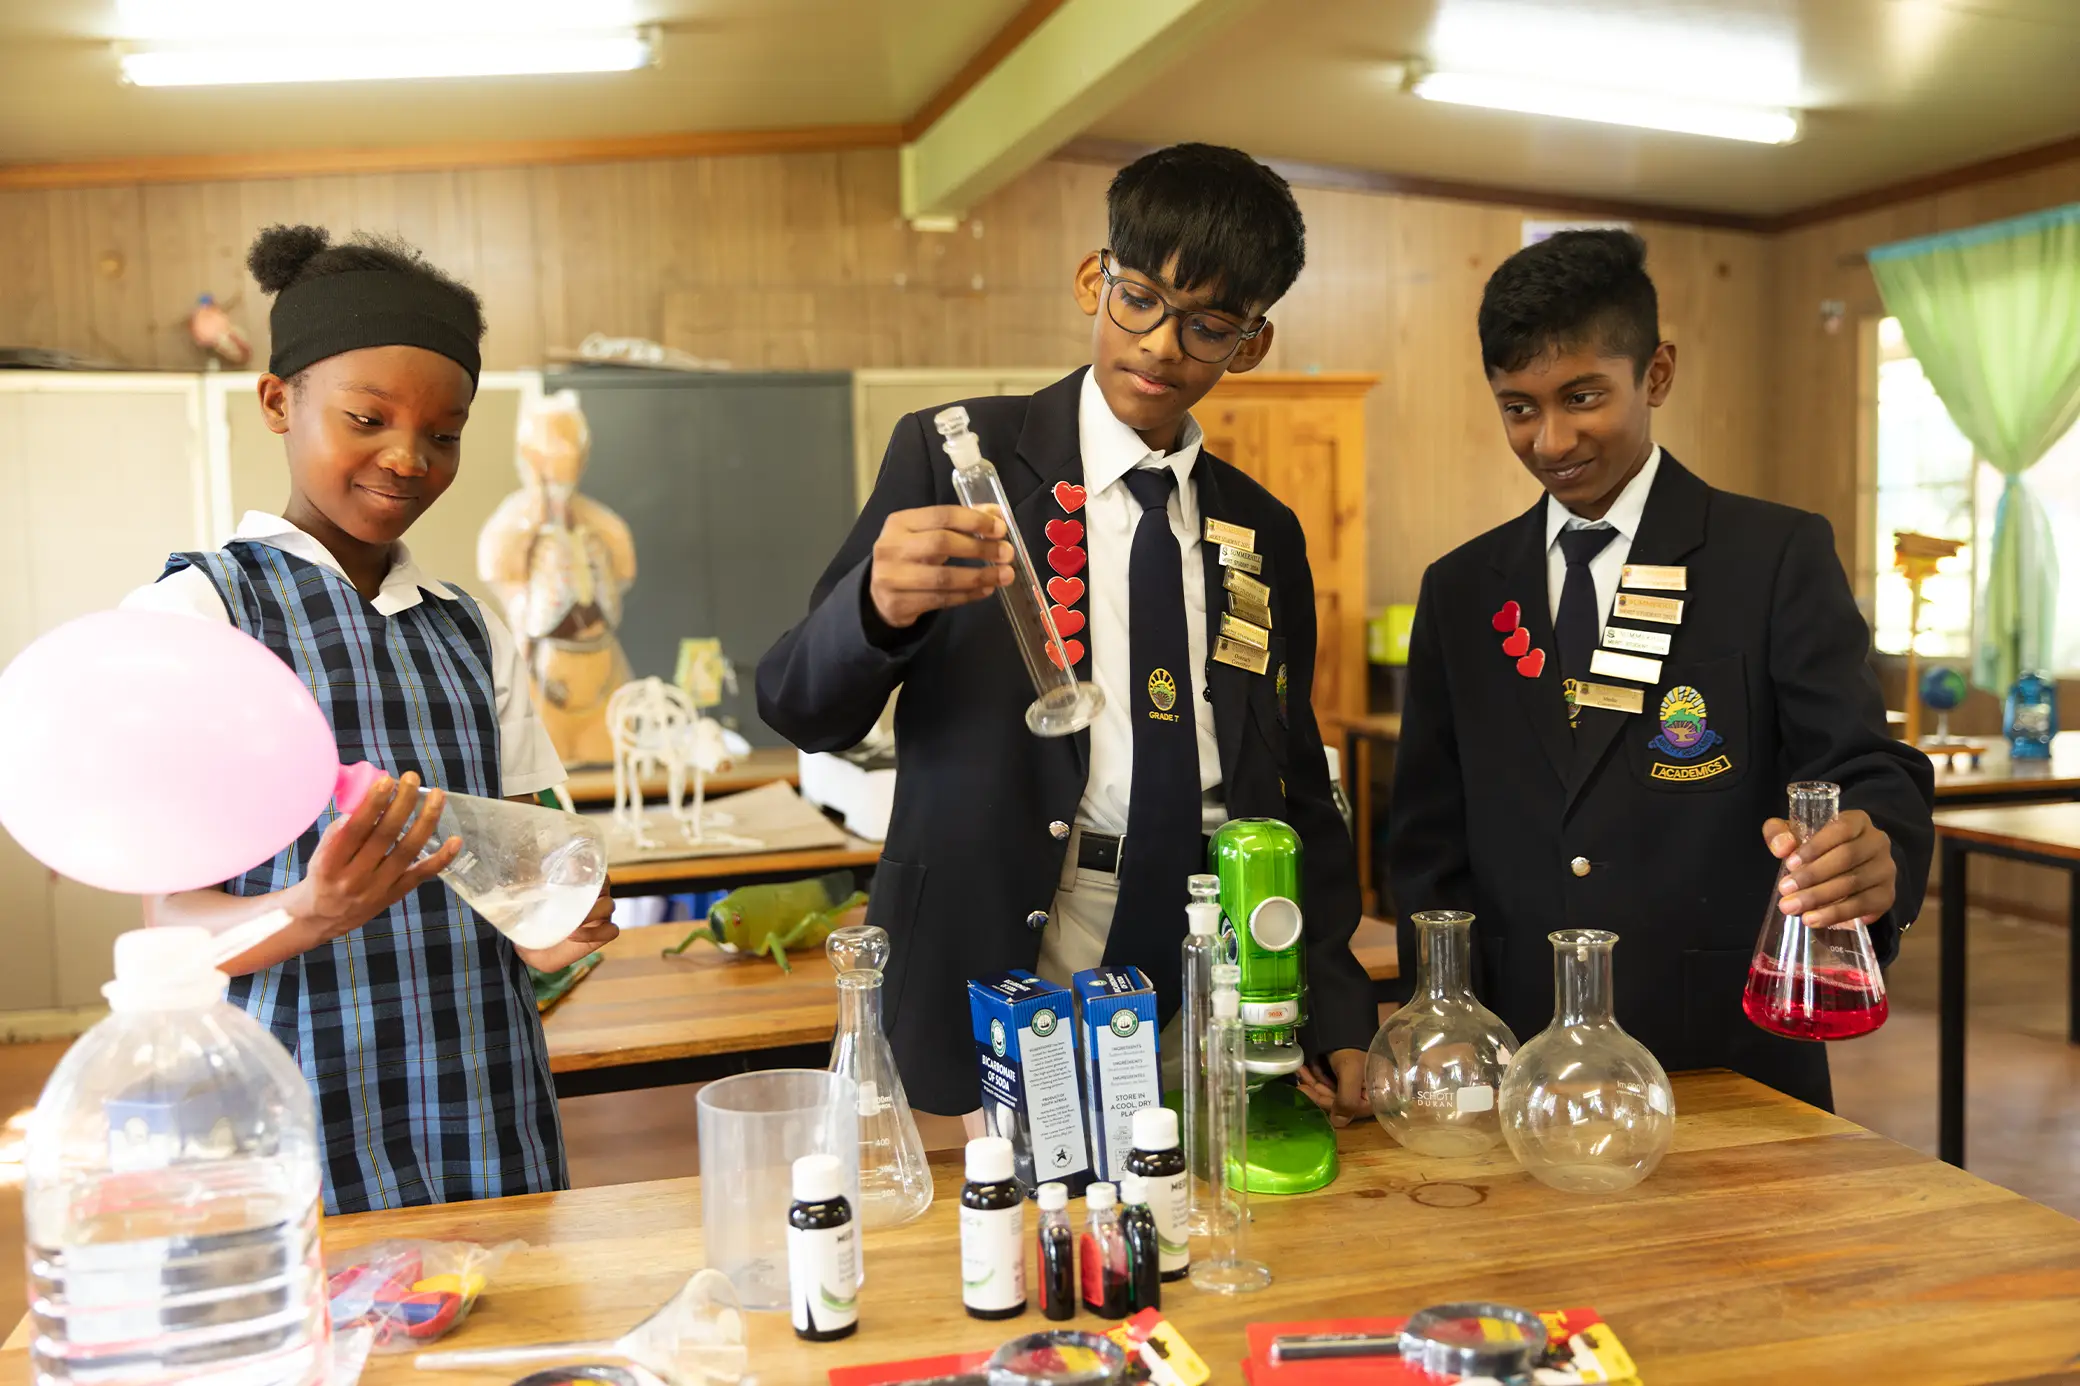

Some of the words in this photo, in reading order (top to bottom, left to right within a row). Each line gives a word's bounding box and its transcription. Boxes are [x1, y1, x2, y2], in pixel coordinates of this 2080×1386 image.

[1149, 711, 1174, 722] GRADE
[1658, 762, 1722, 778] ACADEMICS
[982, 1054, 1016, 1082] BICARBONATE
[988, 1070, 996, 1082] OF
[996, 1074, 1010, 1092] SODA
[1116, 1093, 1136, 1101] STORE
[1417, 1090, 1455, 1101] SCHOTT
[1116, 1102, 1138, 1110] COOL,
[1138, 1100, 1152, 1108] DRY
[875, 1138, 890, 1146] 400
